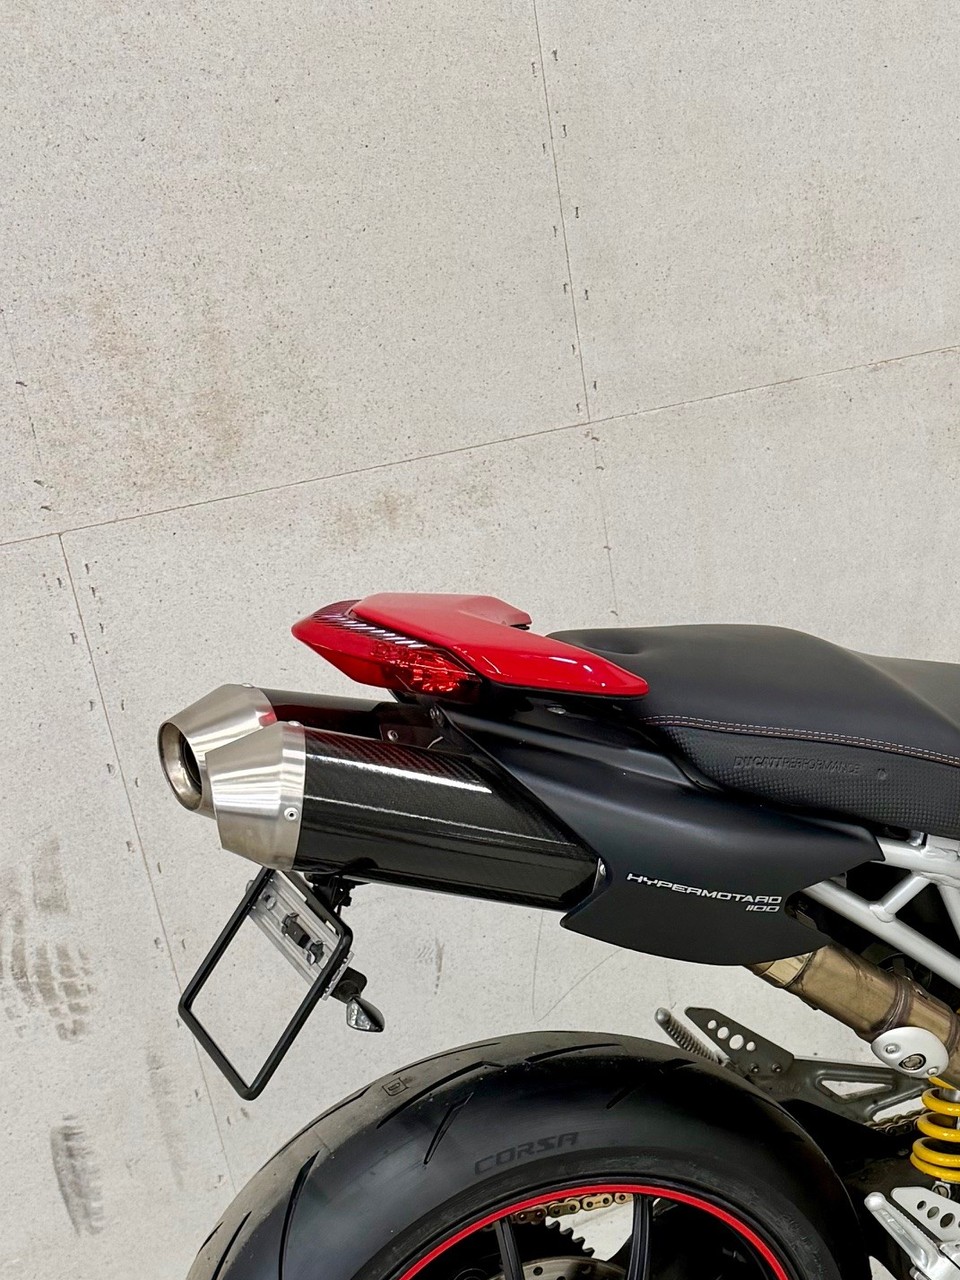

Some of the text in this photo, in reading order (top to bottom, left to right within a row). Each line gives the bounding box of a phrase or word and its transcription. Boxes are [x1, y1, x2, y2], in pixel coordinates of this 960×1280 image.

[626, 873, 782, 904] HYPERMOTARD
[745, 904, 780, 913] 1100
[474, 1131, 579, 1175] CORSA
